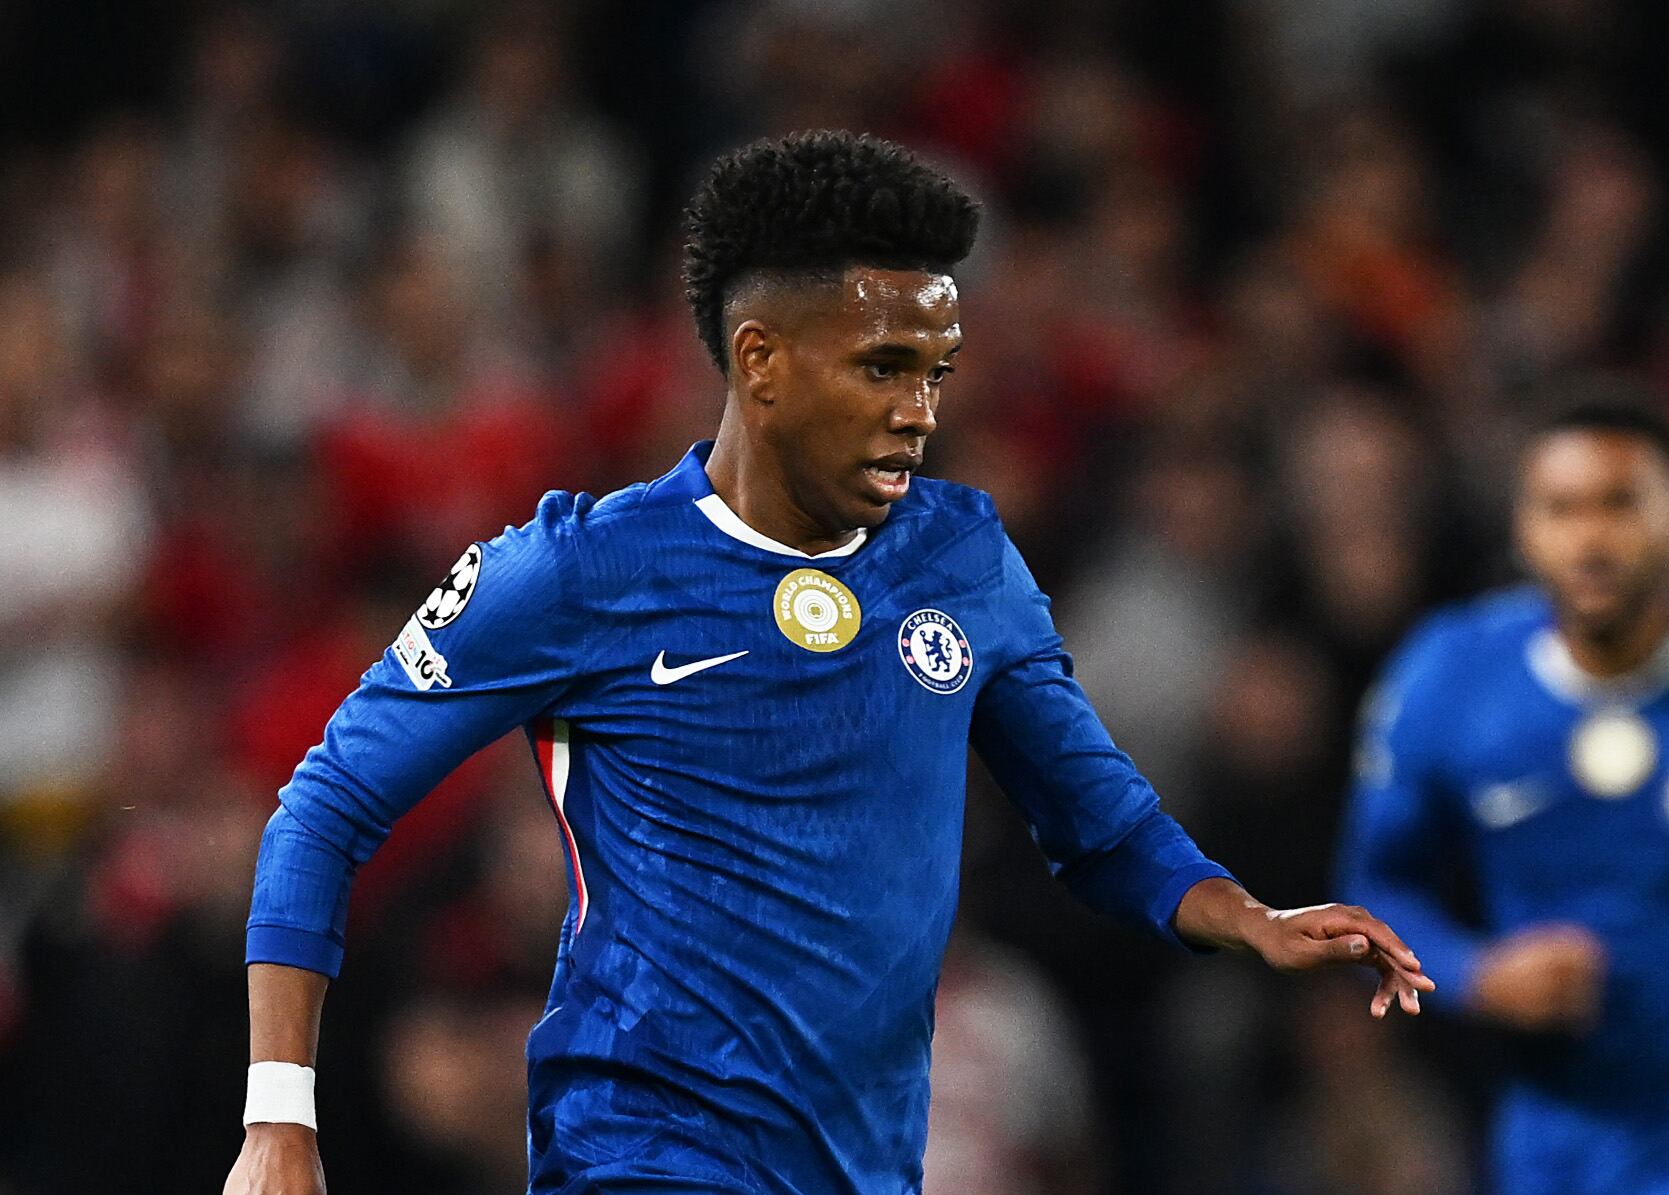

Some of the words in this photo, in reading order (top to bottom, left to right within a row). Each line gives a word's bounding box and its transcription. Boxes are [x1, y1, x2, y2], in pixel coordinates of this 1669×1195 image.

[781, 580, 798, 621] WORLD
[798, 575, 853, 620] CHAMPIONS
[906, 612, 955, 632] CHELSEA
[804, 632, 839, 645] FIFA
